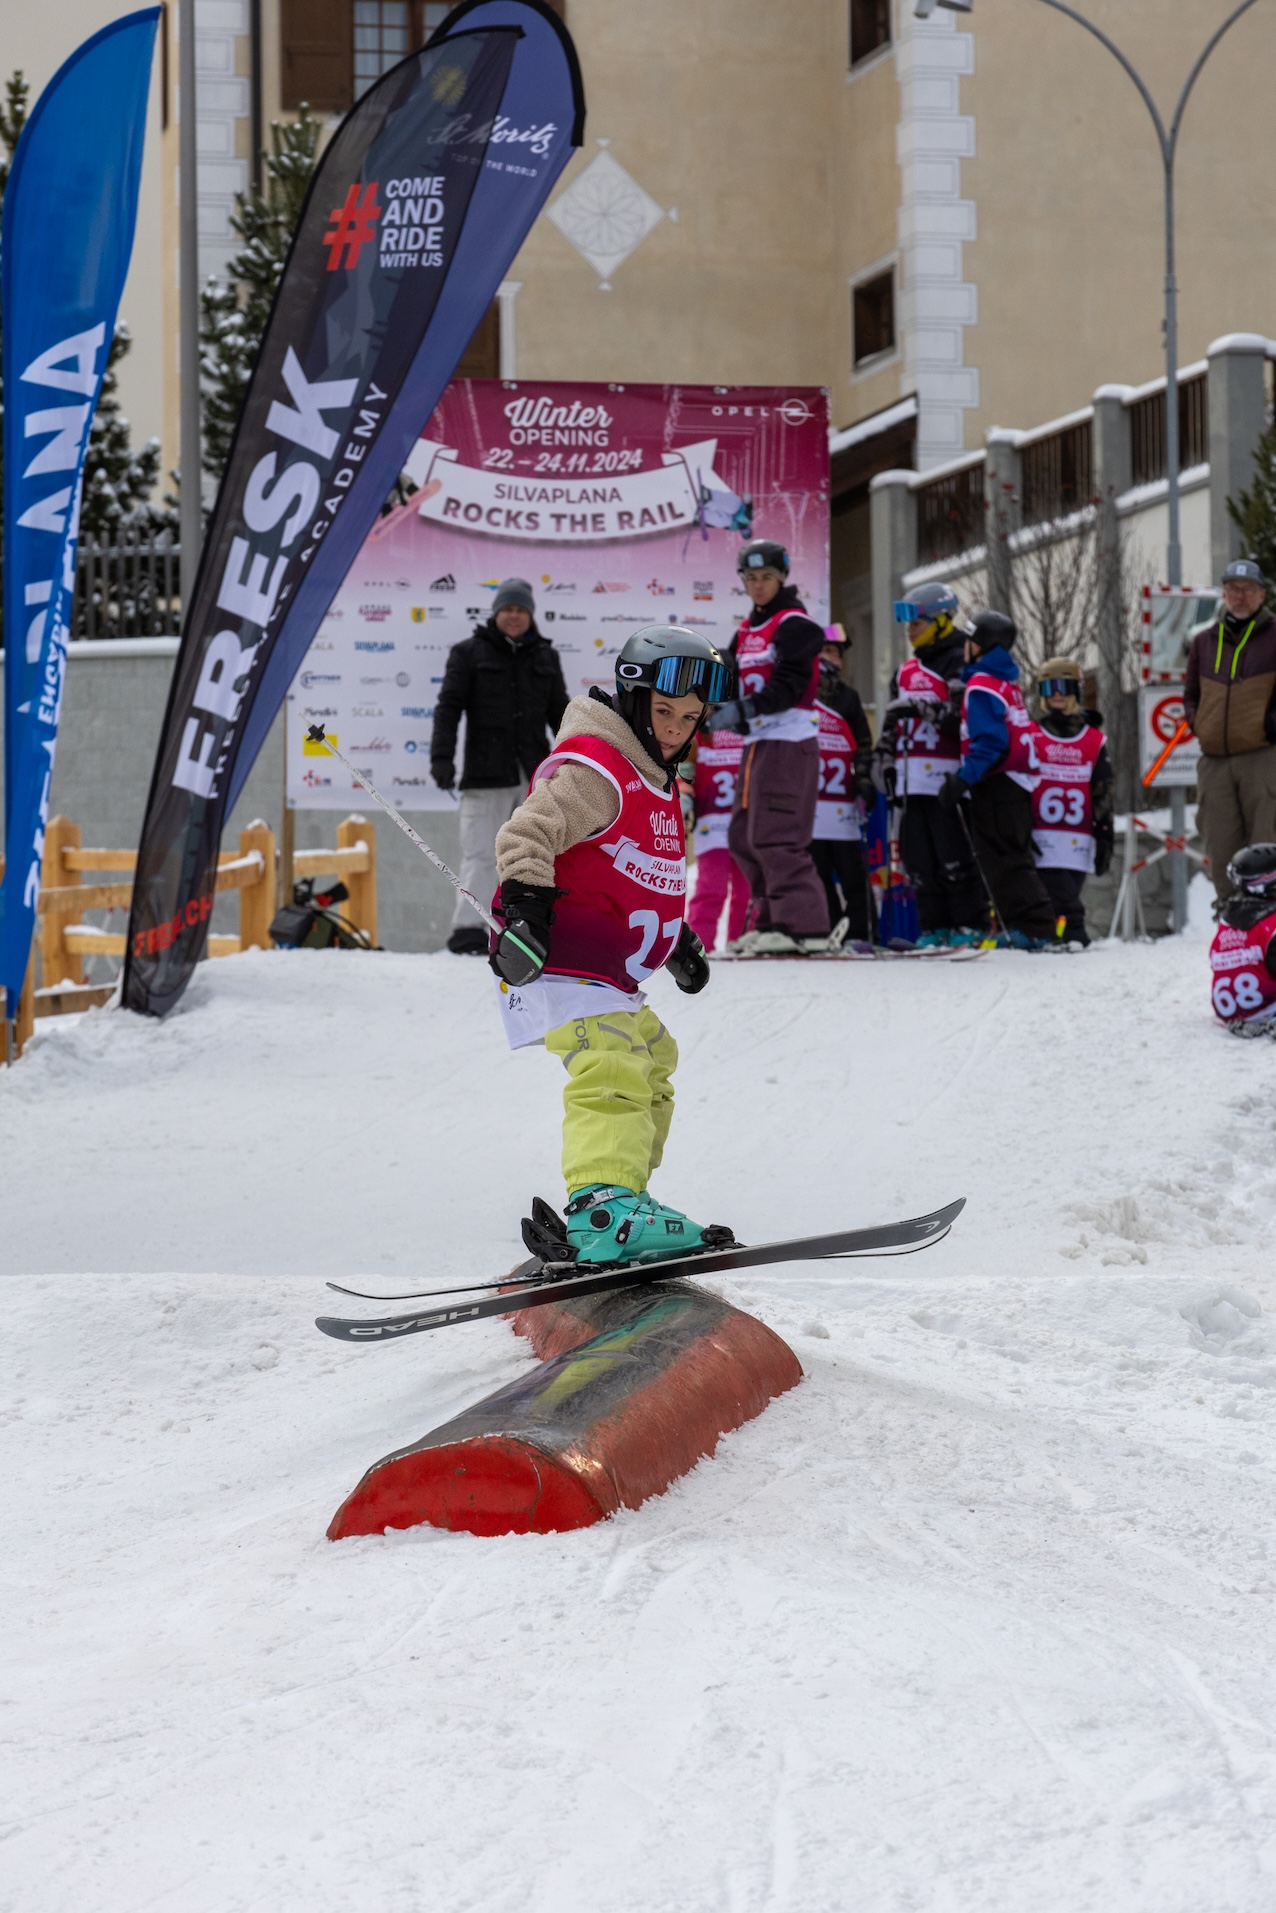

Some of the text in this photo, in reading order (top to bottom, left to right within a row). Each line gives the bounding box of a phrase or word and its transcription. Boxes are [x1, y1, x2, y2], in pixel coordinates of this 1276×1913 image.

[486, 159, 504, 171] THE
[505, 163, 538, 178] WORLD
[385, 176, 446, 199] COME
[381, 198, 445, 227] AND
[380, 227, 444, 252] RIDE
[379, 252, 444, 268] WITH US
[504, 397, 614, 429] Winter
[711, 406, 770, 416] OPEL
[509, 429, 609, 447] OPENING
[301, 382, 388, 562] ACADEMY
[494, 483, 623, 504] SILVAPLANA
[442, 497, 685, 533] ROCKS THE RAIL
[172, 344, 360, 798] FRESK
[712, 770, 740, 808] 3
[1039, 786, 1085, 825] 63
[625, 861, 667, 890] ROCKS
[624, 909, 683, 983] 27
[1213, 971, 1264, 1018] 68
[349, 1306, 480, 1336] HEAD
